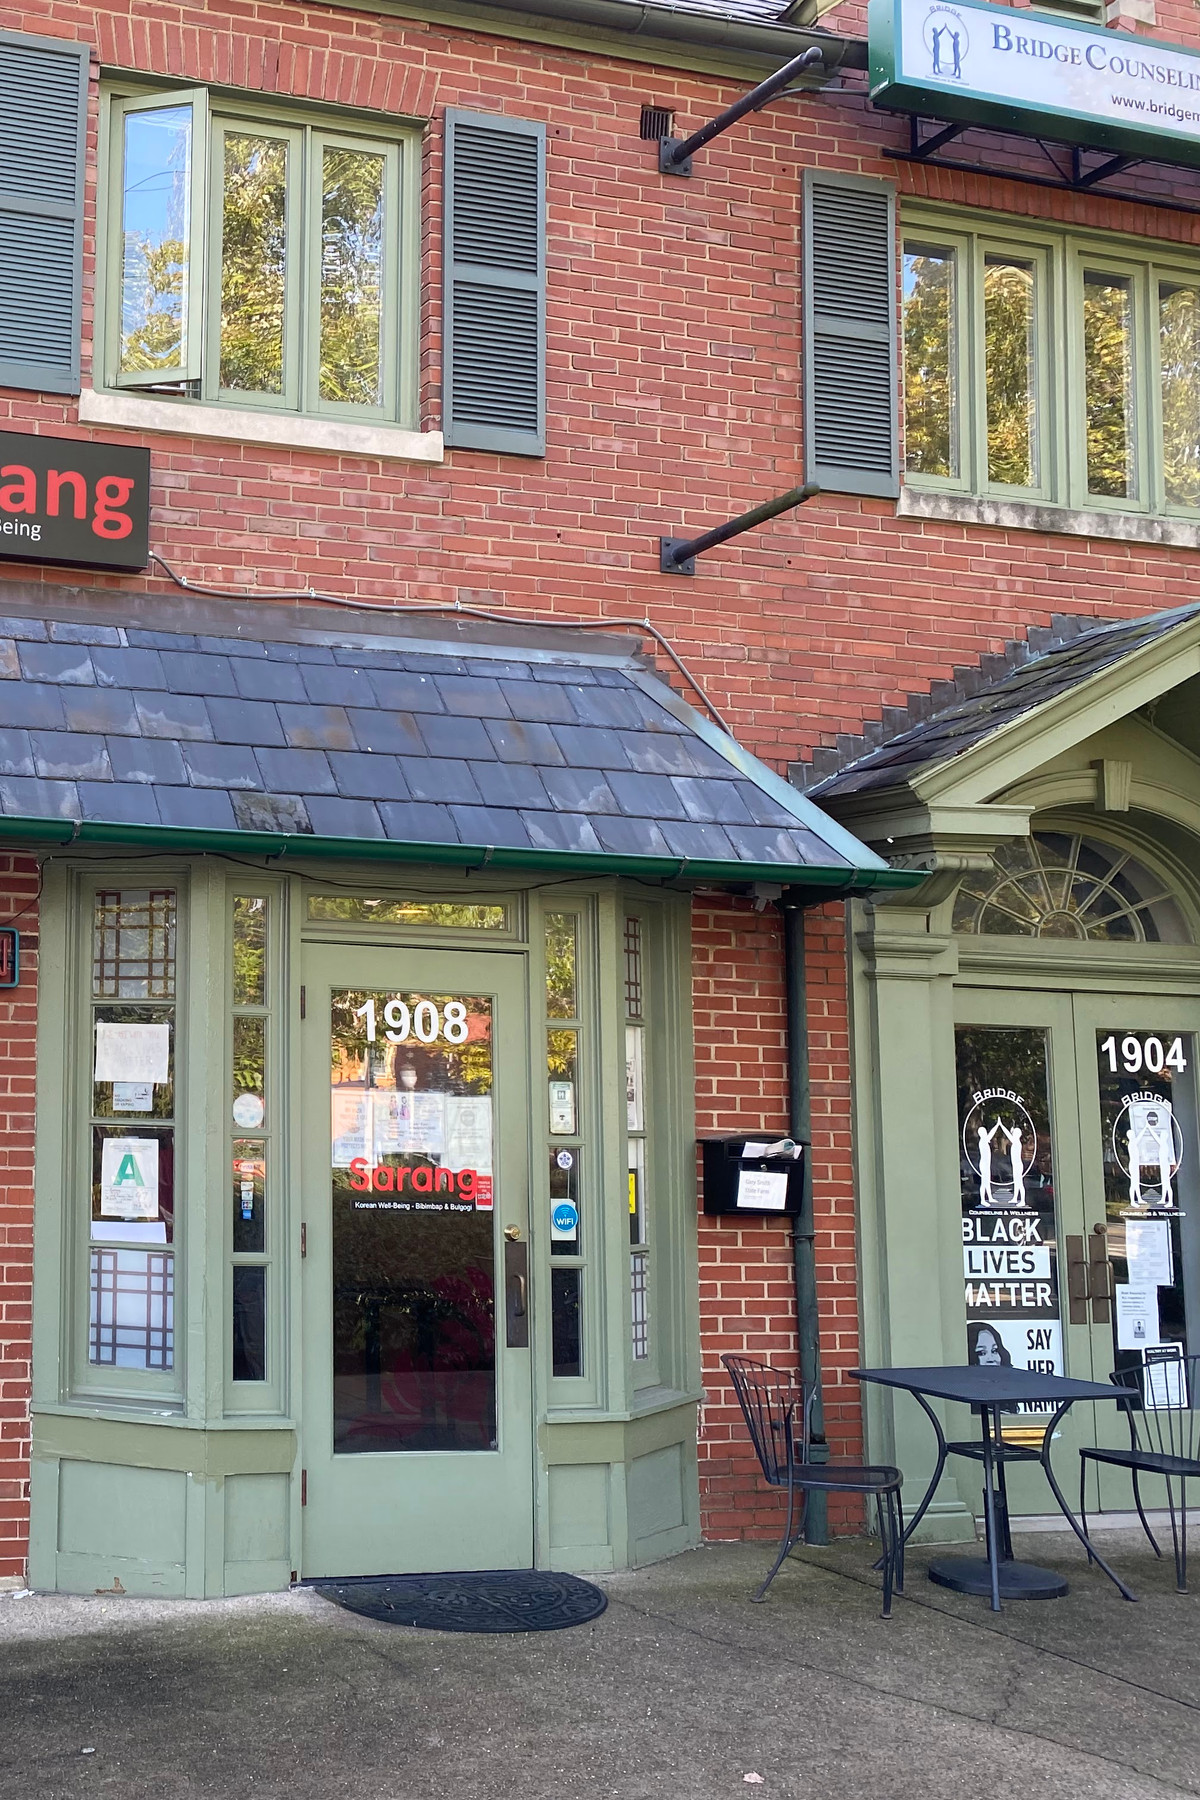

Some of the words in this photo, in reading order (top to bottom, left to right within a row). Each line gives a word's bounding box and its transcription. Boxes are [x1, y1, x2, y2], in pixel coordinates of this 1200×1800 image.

[356, 999, 469, 1044] 1908
[1101, 1036, 1187, 1073] 1904
[972, 1087, 1025, 1106] BRIDGE
[1120, 1091, 1172, 1110] BRIDGE
[113, 1154, 145, 1187] A
[349, 1157, 477, 1201] Sarang
[378, 1202, 410, 1211] Well-Being
[415, 1203, 443, 1211] Bibimbap
[450, 1203, 473, 1212] Bulgogi
[962, 1217, 1043, 1242] BLACK
[968, 1250, 1036, 1274] LIVES
[1026, 1328, 1052, 1350] SAY
[1023, 1400, 1062, 1413] NAM
